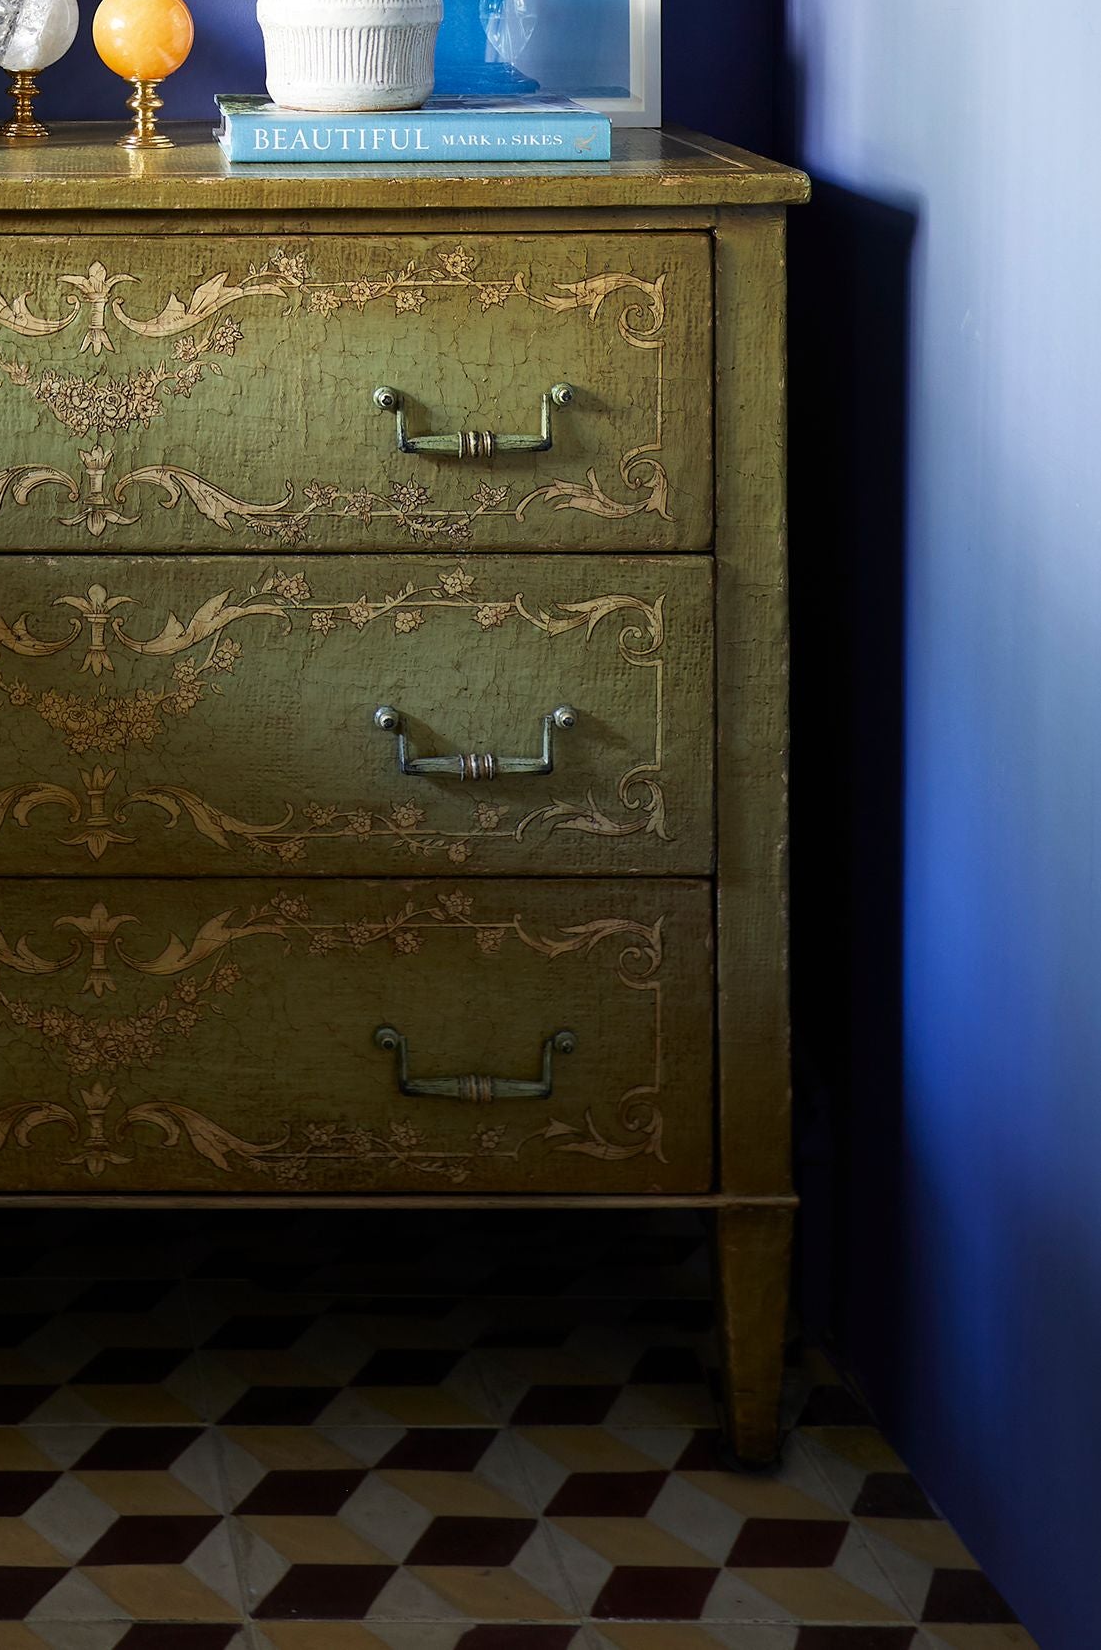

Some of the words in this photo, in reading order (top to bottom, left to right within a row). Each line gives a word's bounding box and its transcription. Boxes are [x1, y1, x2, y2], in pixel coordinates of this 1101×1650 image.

[253, 128, 430, 150] BEAUTIFUL
[441, 133, 492, 146] MARK
[511, 133, 563, 146] SIKES
